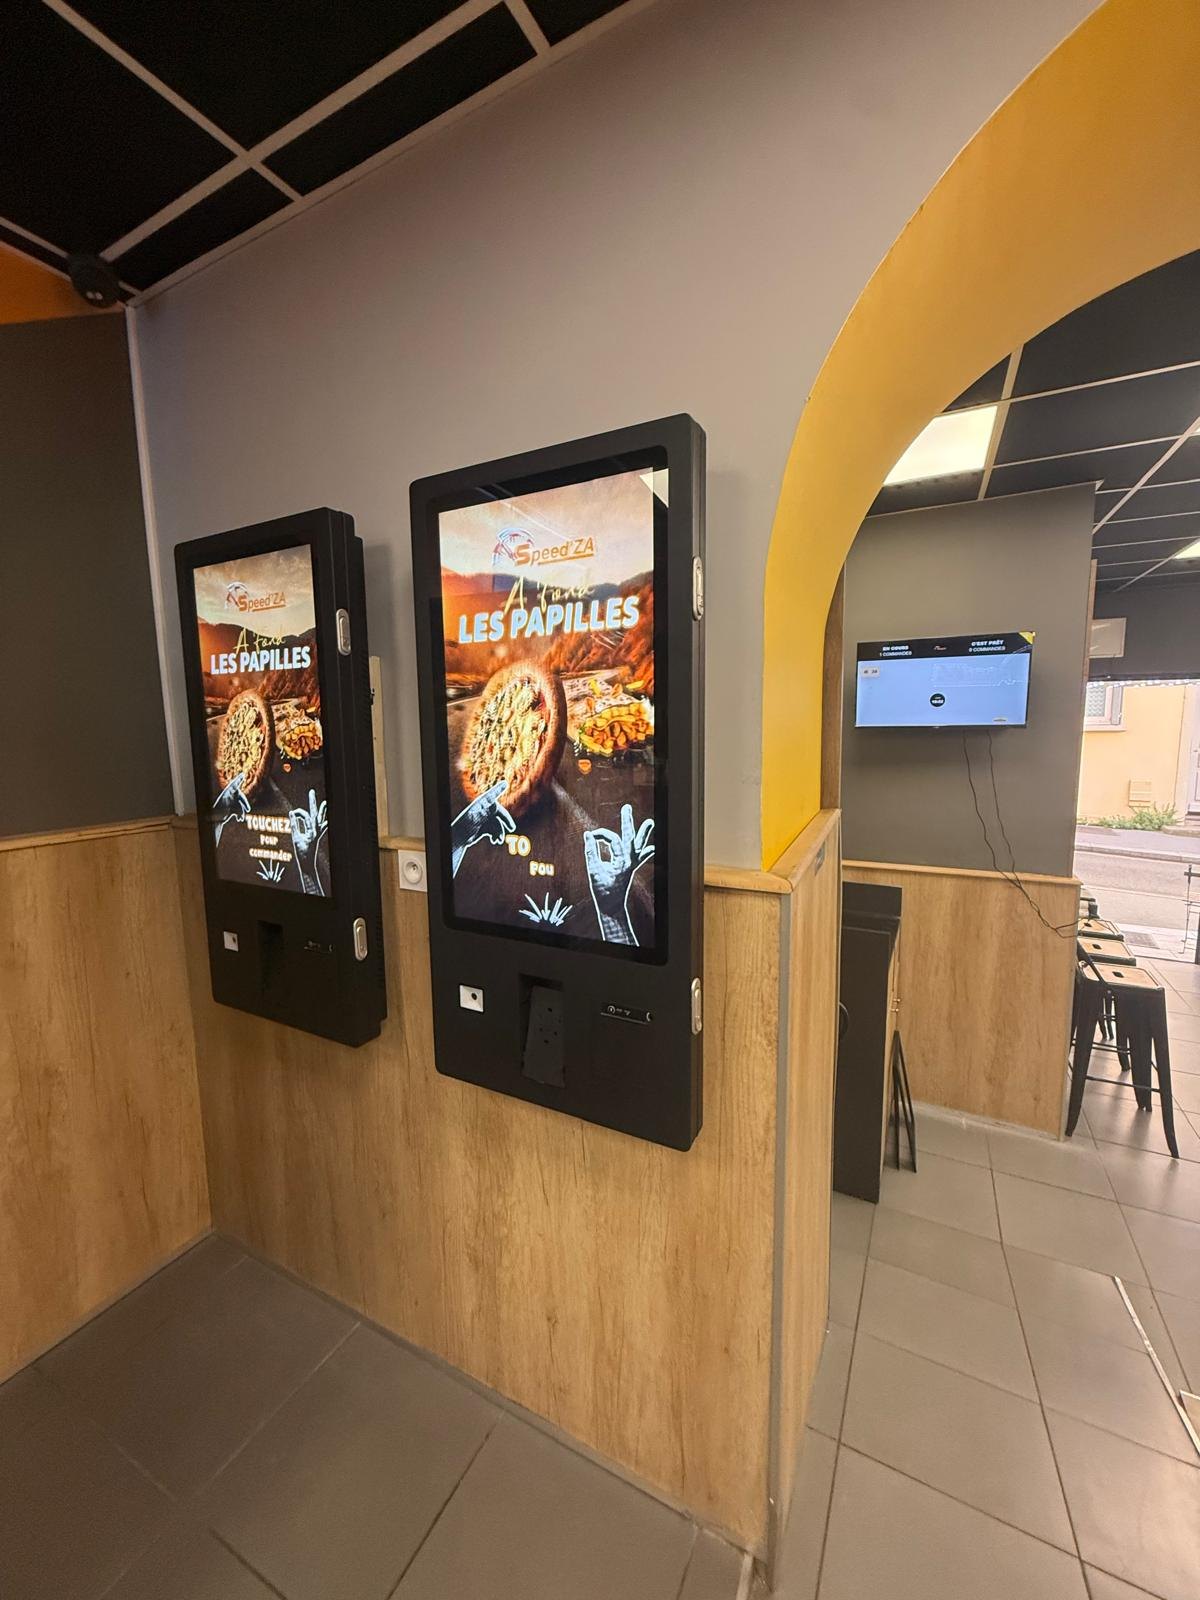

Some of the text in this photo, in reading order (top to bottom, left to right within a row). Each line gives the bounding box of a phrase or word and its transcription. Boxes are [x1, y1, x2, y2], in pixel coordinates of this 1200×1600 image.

[514, 537, 596, 567] Speed'ZA
[238, 591, 286, 612] Speed'ZA
[458, 595, 640, 644] LES PAPILLES
[210, 646, 311, 675] LES PAPILLES
[245, 813, 292, 834] TOUCHEZ
[504, 834, 532, 857] TO
